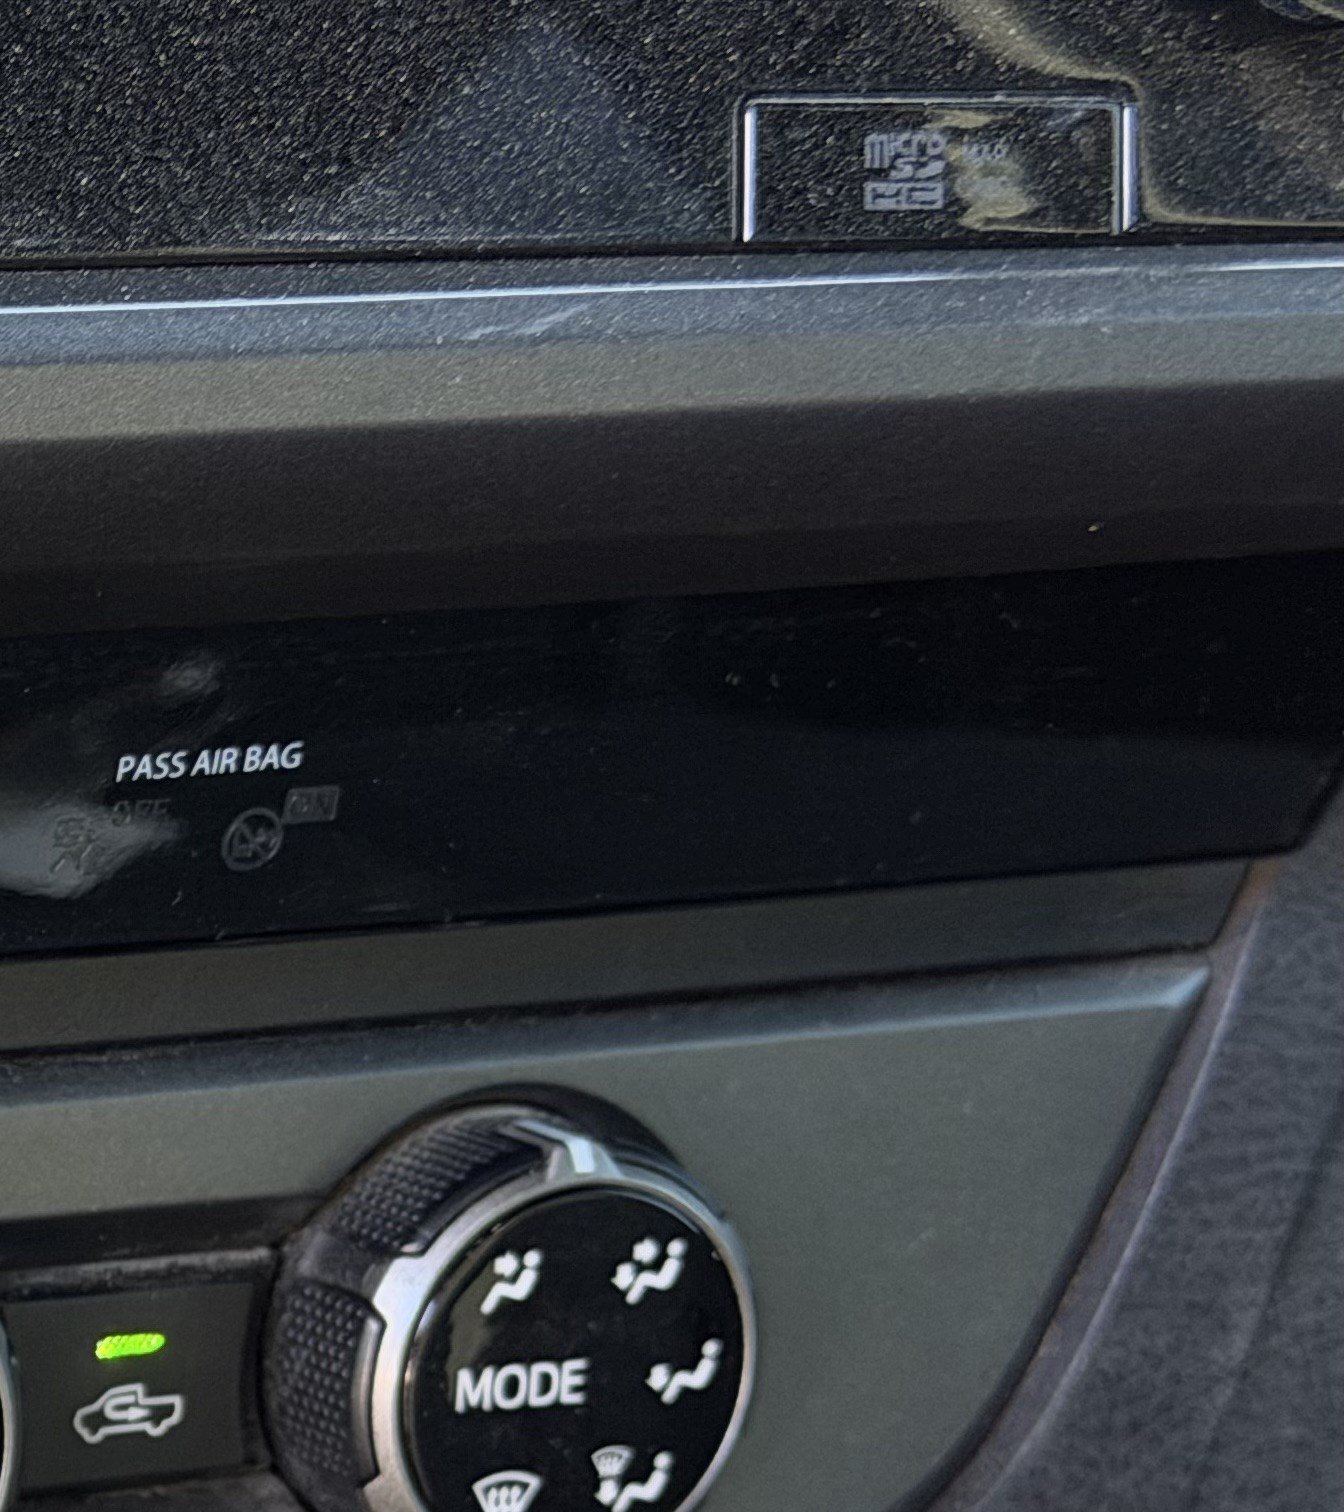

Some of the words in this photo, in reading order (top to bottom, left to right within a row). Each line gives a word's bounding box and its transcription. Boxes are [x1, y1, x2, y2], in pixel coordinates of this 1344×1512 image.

[115, 751, 188, 783] PASS
[190, 747, 239, 777] AIR
[242, 740, 305, 773] BAG
[454, 1357, 589, 1414] MODE
